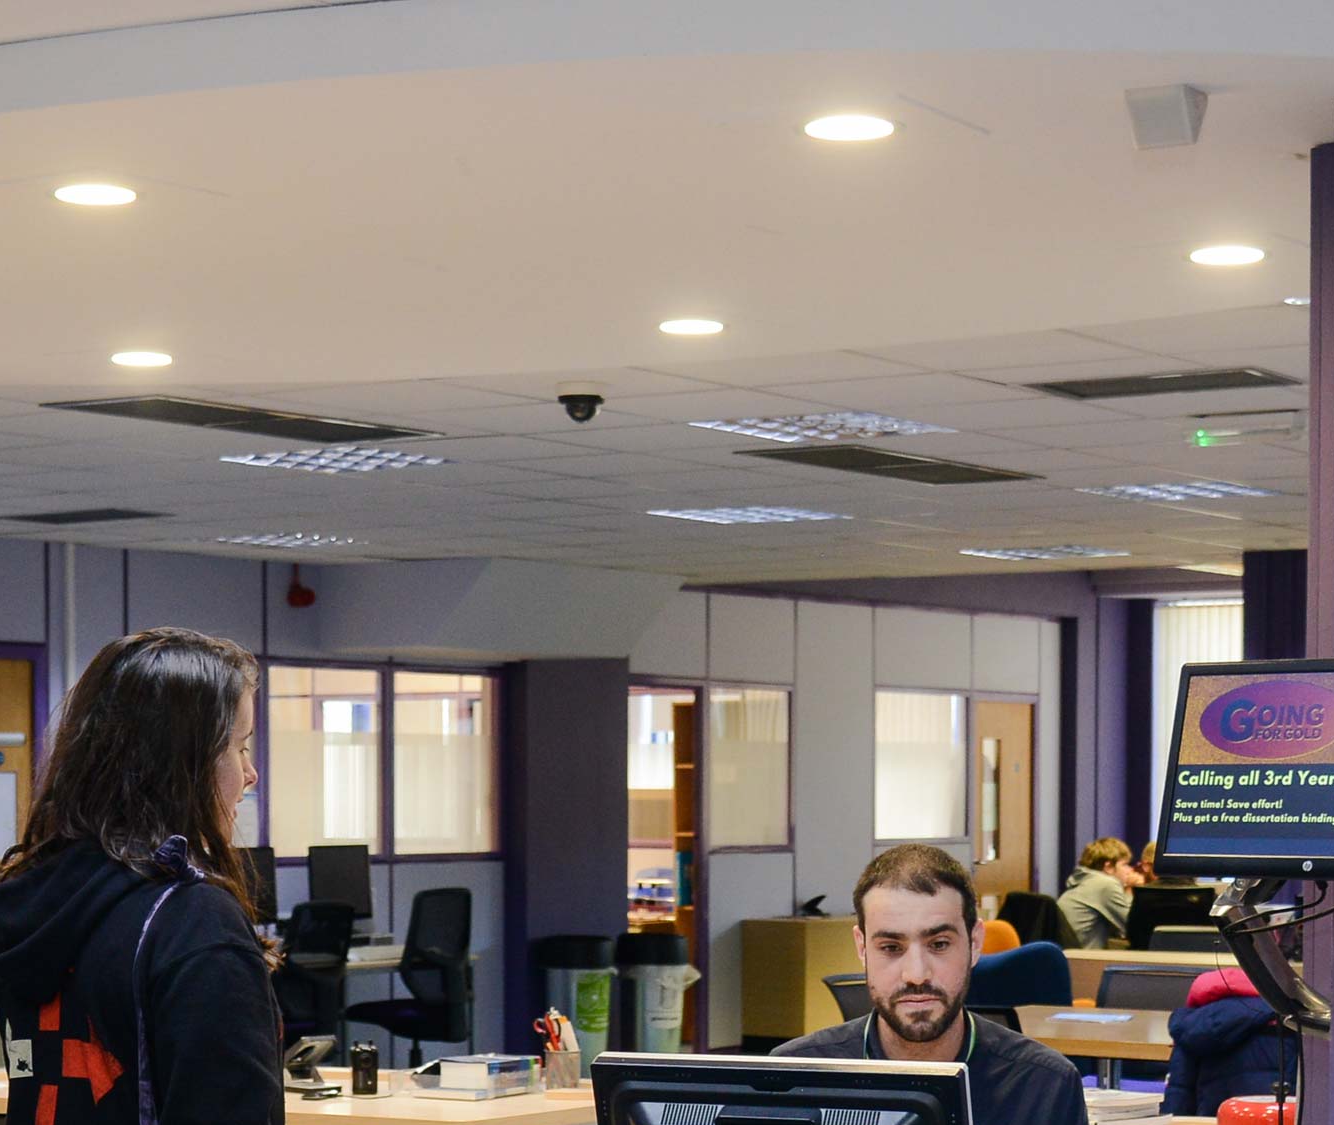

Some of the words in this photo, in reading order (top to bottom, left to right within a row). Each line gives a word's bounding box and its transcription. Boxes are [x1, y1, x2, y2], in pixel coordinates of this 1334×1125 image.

[1220, 698, 1325, 743] GOING
[1255, 728, 1281, 741] FOR
[1283, 728, 1323, 741] GOLD
[1178, 770, 1234, 790] Calling
[1238, 770, 1260, 786] all
[1263, 770, 1293, 786] 3rd
[1175, 799, 1198, 809] Save
[1200, 799, 1225, 809] time!
[1226, 799, 1250, 809] Save
[1251, 799, 1283, 809] effort!
[1173, 813, 1193, 823] Plus
[1194, 814, 1210, 825] get
[1212, 815, 1218, 823] a
[1220, 813, 1240, 823] free
[1242, 813, 1299, 823] dissertation
